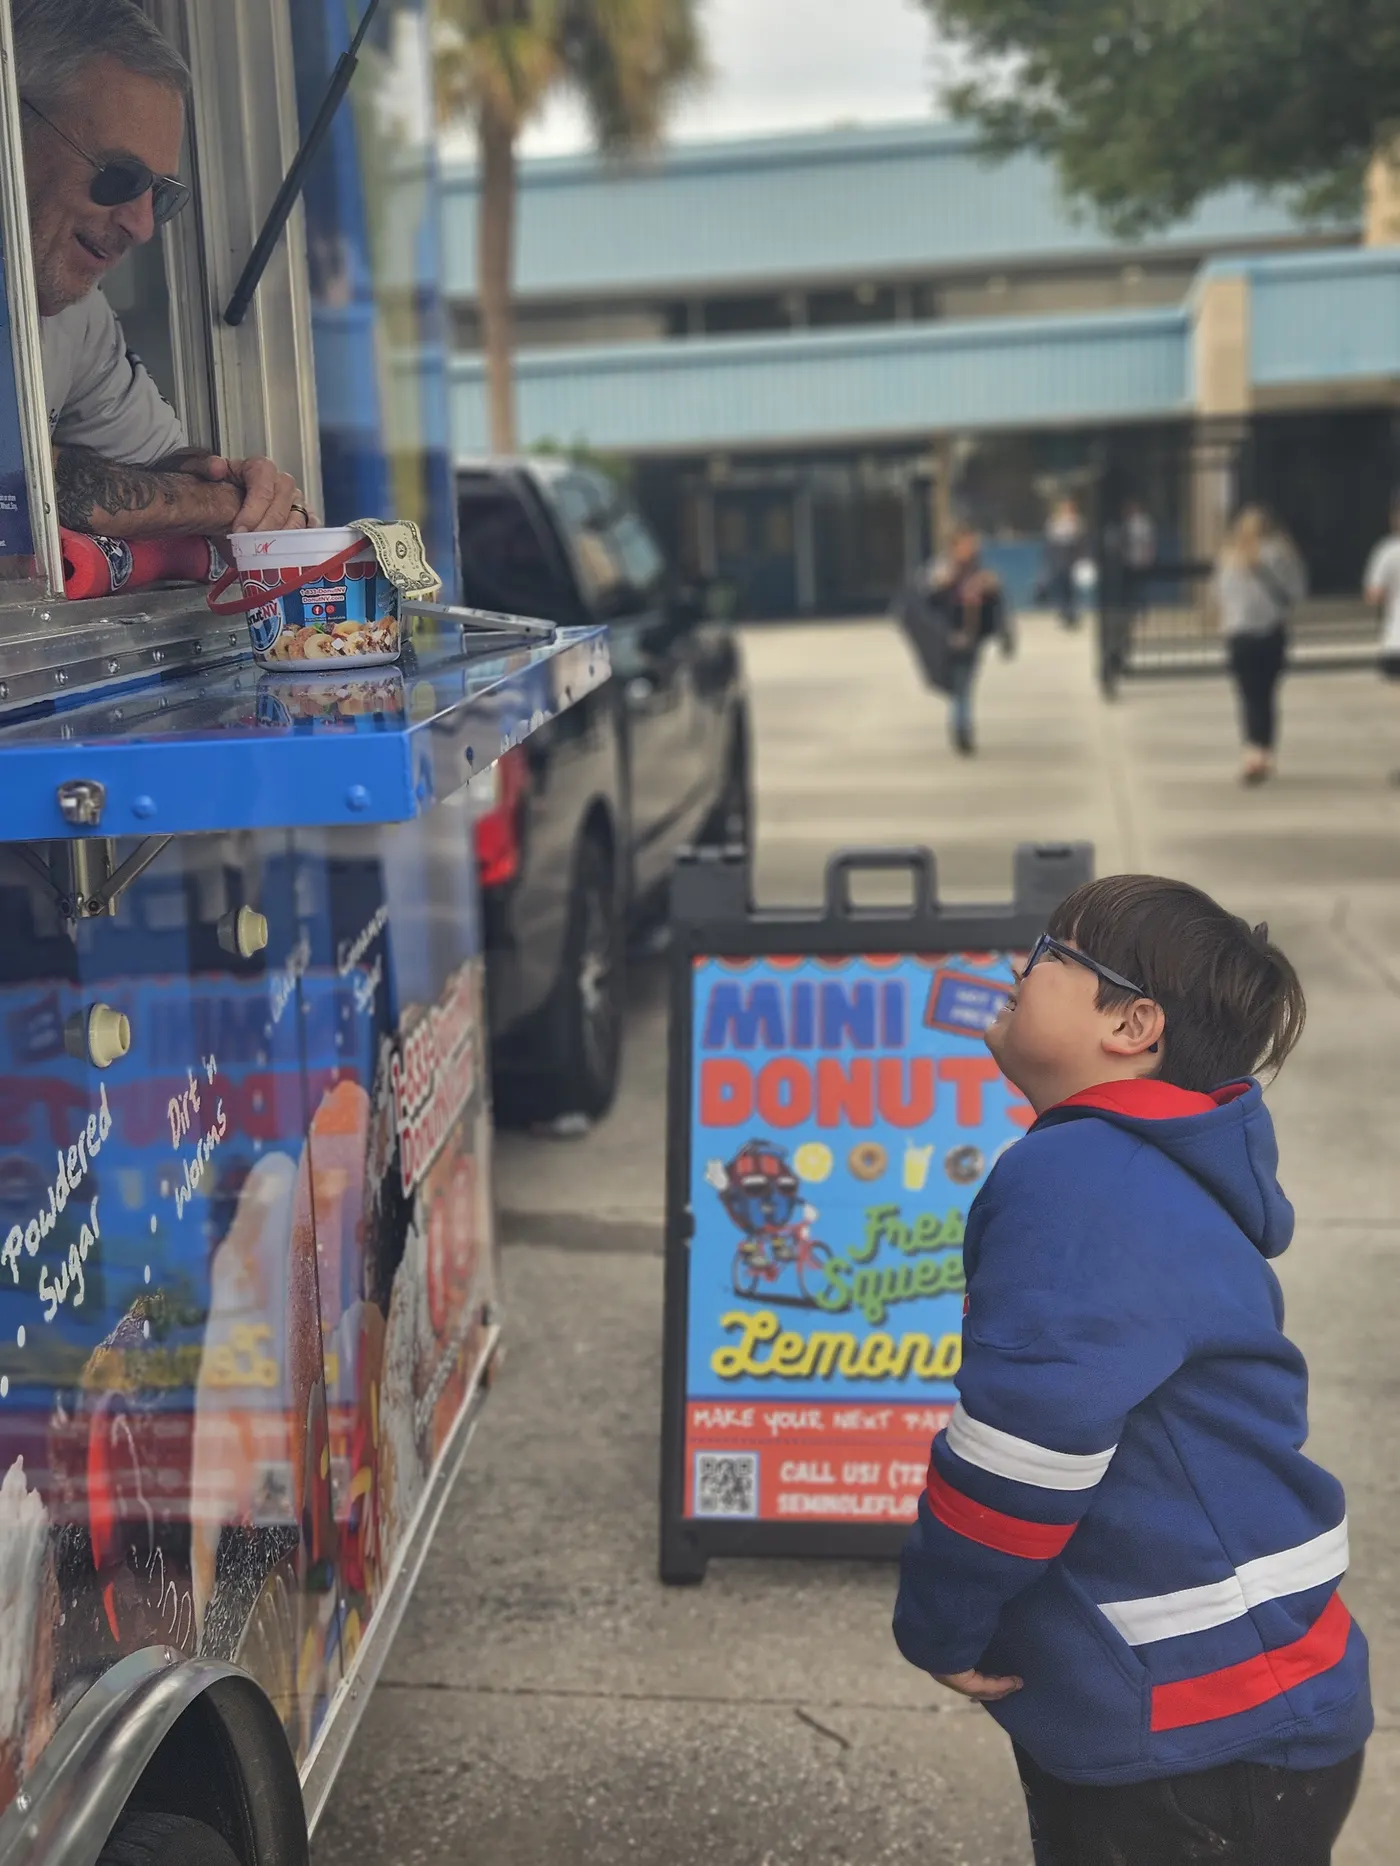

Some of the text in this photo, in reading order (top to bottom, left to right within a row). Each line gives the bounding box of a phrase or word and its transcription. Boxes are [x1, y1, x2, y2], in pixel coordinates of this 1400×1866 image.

[703, 979, 908, 1050] MINI
[167, 1068, 201, 1150] Dirt
[1, 1082, 112, 1284] Powdered
[38, 1196, 100, 1322] Sugar
[694, 1409, 754, 1430] MAKE
[832, 1411, 893, 1431] NEXT
[780, 1461, 835, 1483] CALL
